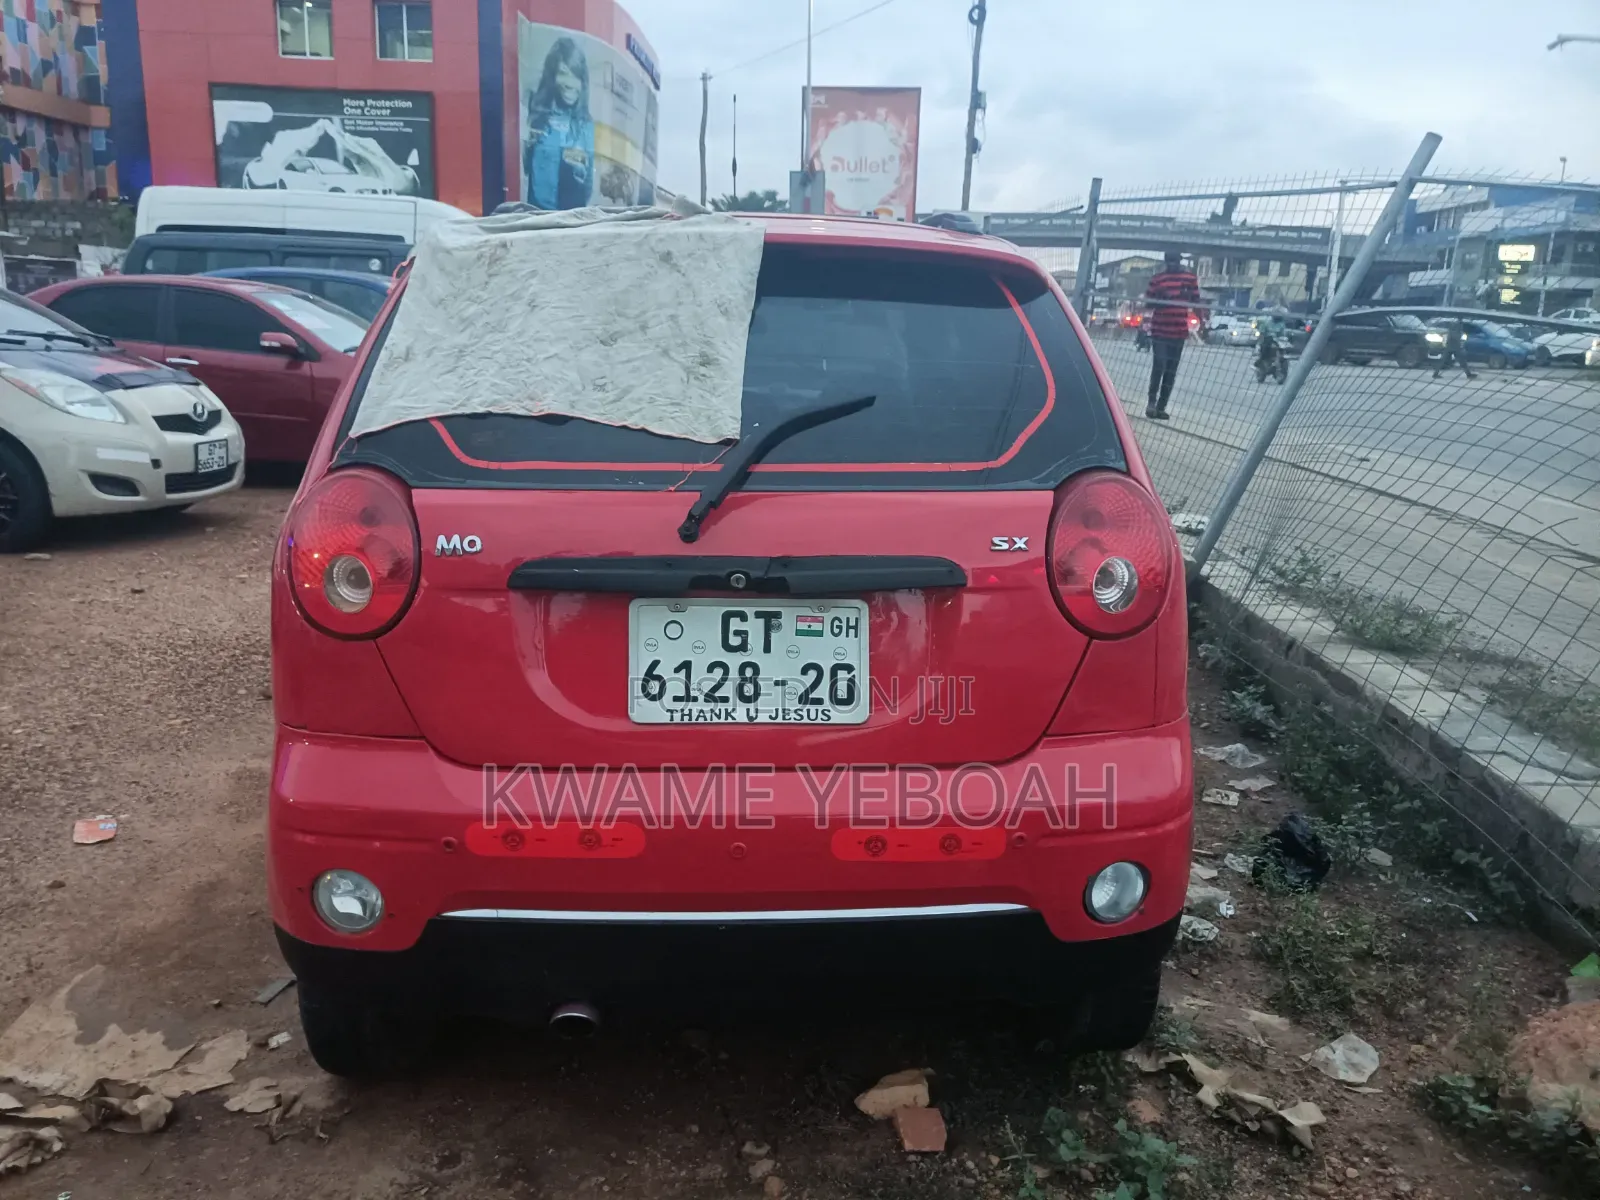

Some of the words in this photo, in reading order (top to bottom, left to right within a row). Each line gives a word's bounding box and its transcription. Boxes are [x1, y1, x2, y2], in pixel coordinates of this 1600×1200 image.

[343, 98, 365, 107] More
[367, 98, 413, 108] Protection
[343, 106, 361, 115] One
[364, 106, 391, 116] Cover
[990, 536, 1029, 551] SX
[720, 609, 783, 654] GT
[830, 616, 859, 638] GH
[666, 704, 737, 722] THANK
[746, 704, 759, 723] U
[768, 704, 832, 722] JESUS
